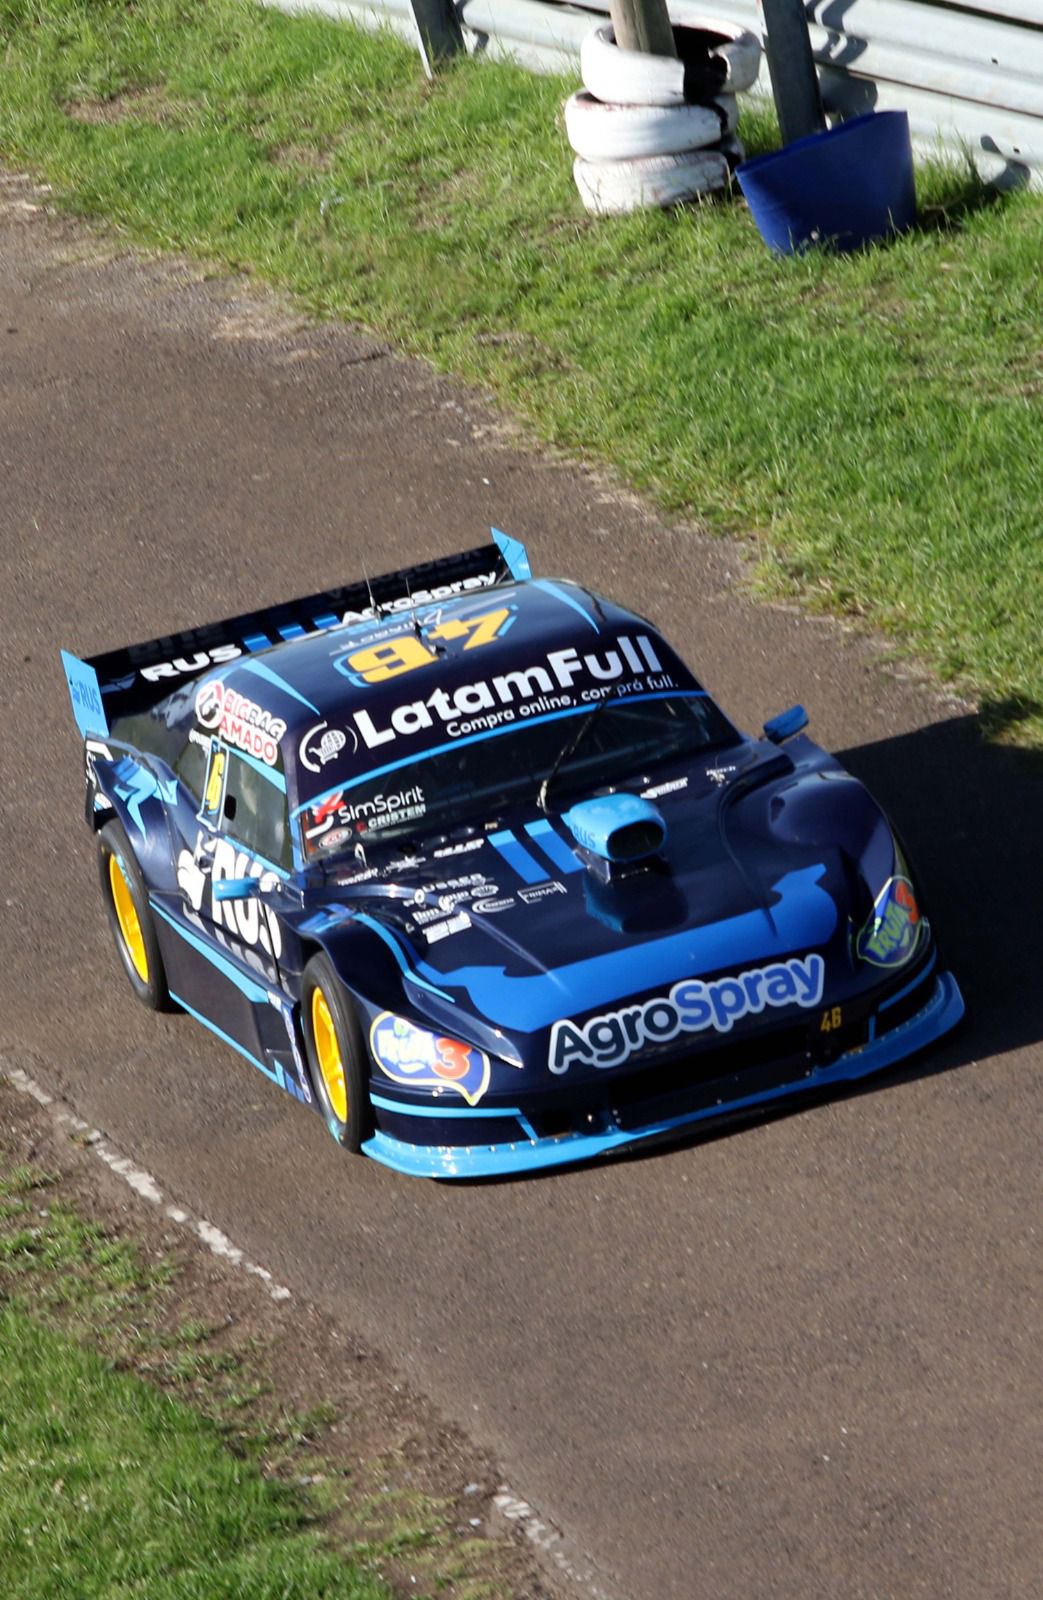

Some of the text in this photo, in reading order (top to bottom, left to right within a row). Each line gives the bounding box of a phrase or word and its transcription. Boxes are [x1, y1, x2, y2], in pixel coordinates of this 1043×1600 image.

[140, 644, 242, 682] RUS
[80, 680, 101, 715] RUS
[353, 636, 663, 749] LatamFull
[446, 709, 515, 737] Compra
[519, 691, 577, 717] online,
[219, 714, 277, 764] AMADO
[338, 785, 425, 824] SimSpirit
[549, 954, 824, 1074] AgroSpray
